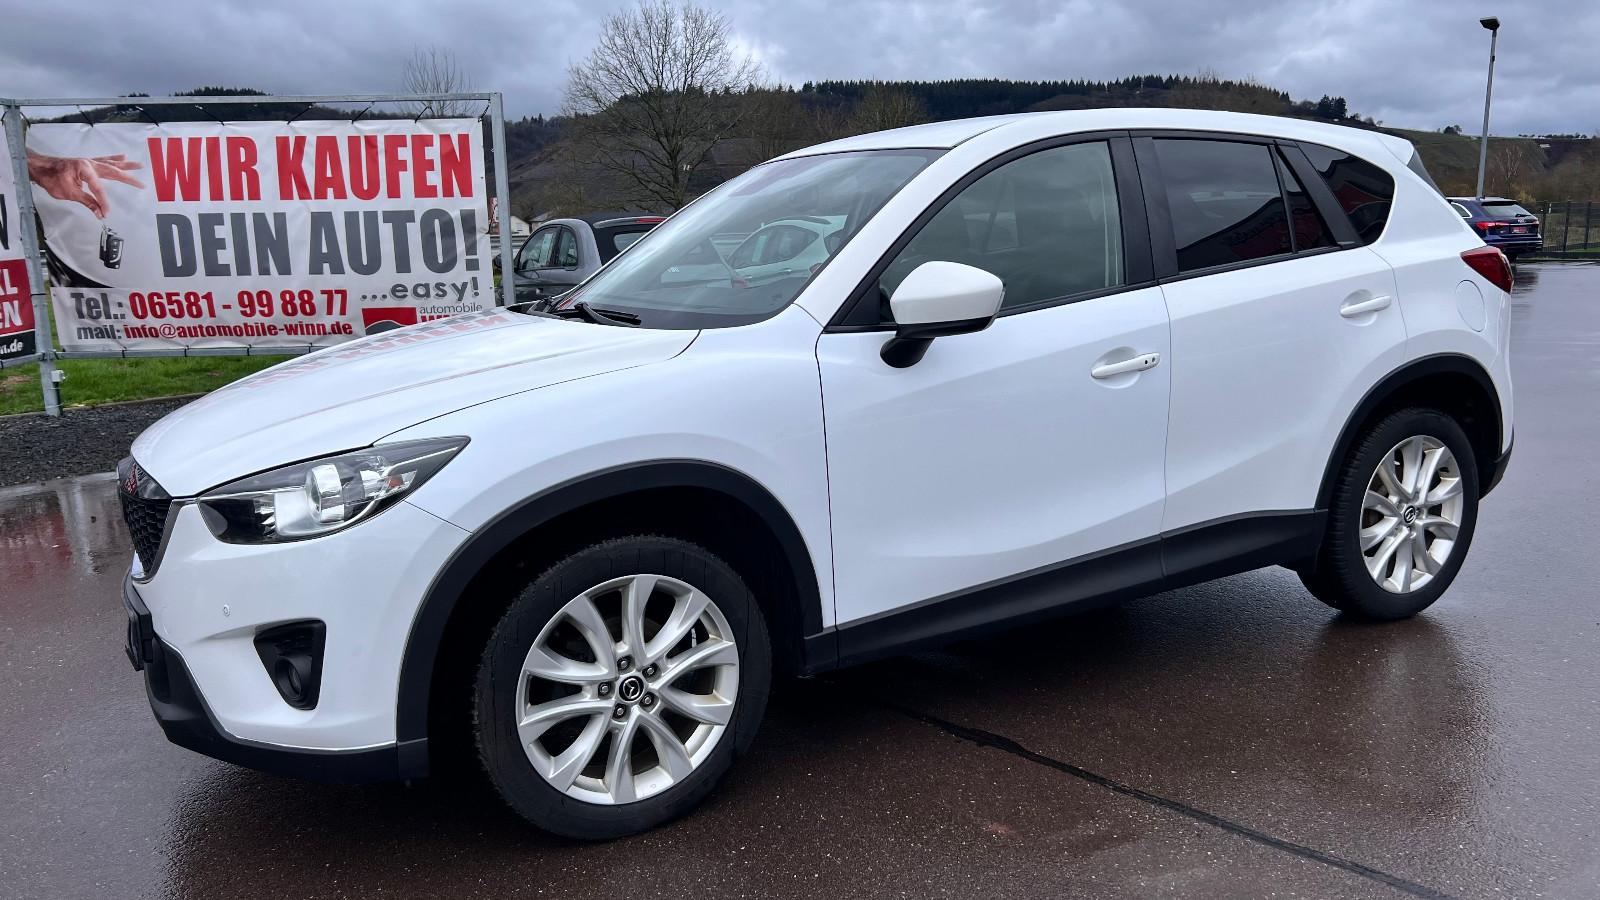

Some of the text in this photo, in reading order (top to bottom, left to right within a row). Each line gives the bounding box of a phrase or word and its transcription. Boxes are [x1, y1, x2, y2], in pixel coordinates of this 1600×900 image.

[147, 133, 474, 202] WIR KAUFEN
[156, 208, 480, 278] DEIN AUTO!
[70, 292, 126, 320] Tel.:
[128, 291, 217, 320] 06581
[237, 290, 275, 319] 99
[279, 289, 317, 318] 88
[320, 289, 348, 317] 77
[419, 302, 483, 315] automobile
[76, 324, 122, 341] mail:
[124, 320, 354, 340] info@automobile-winn.de
